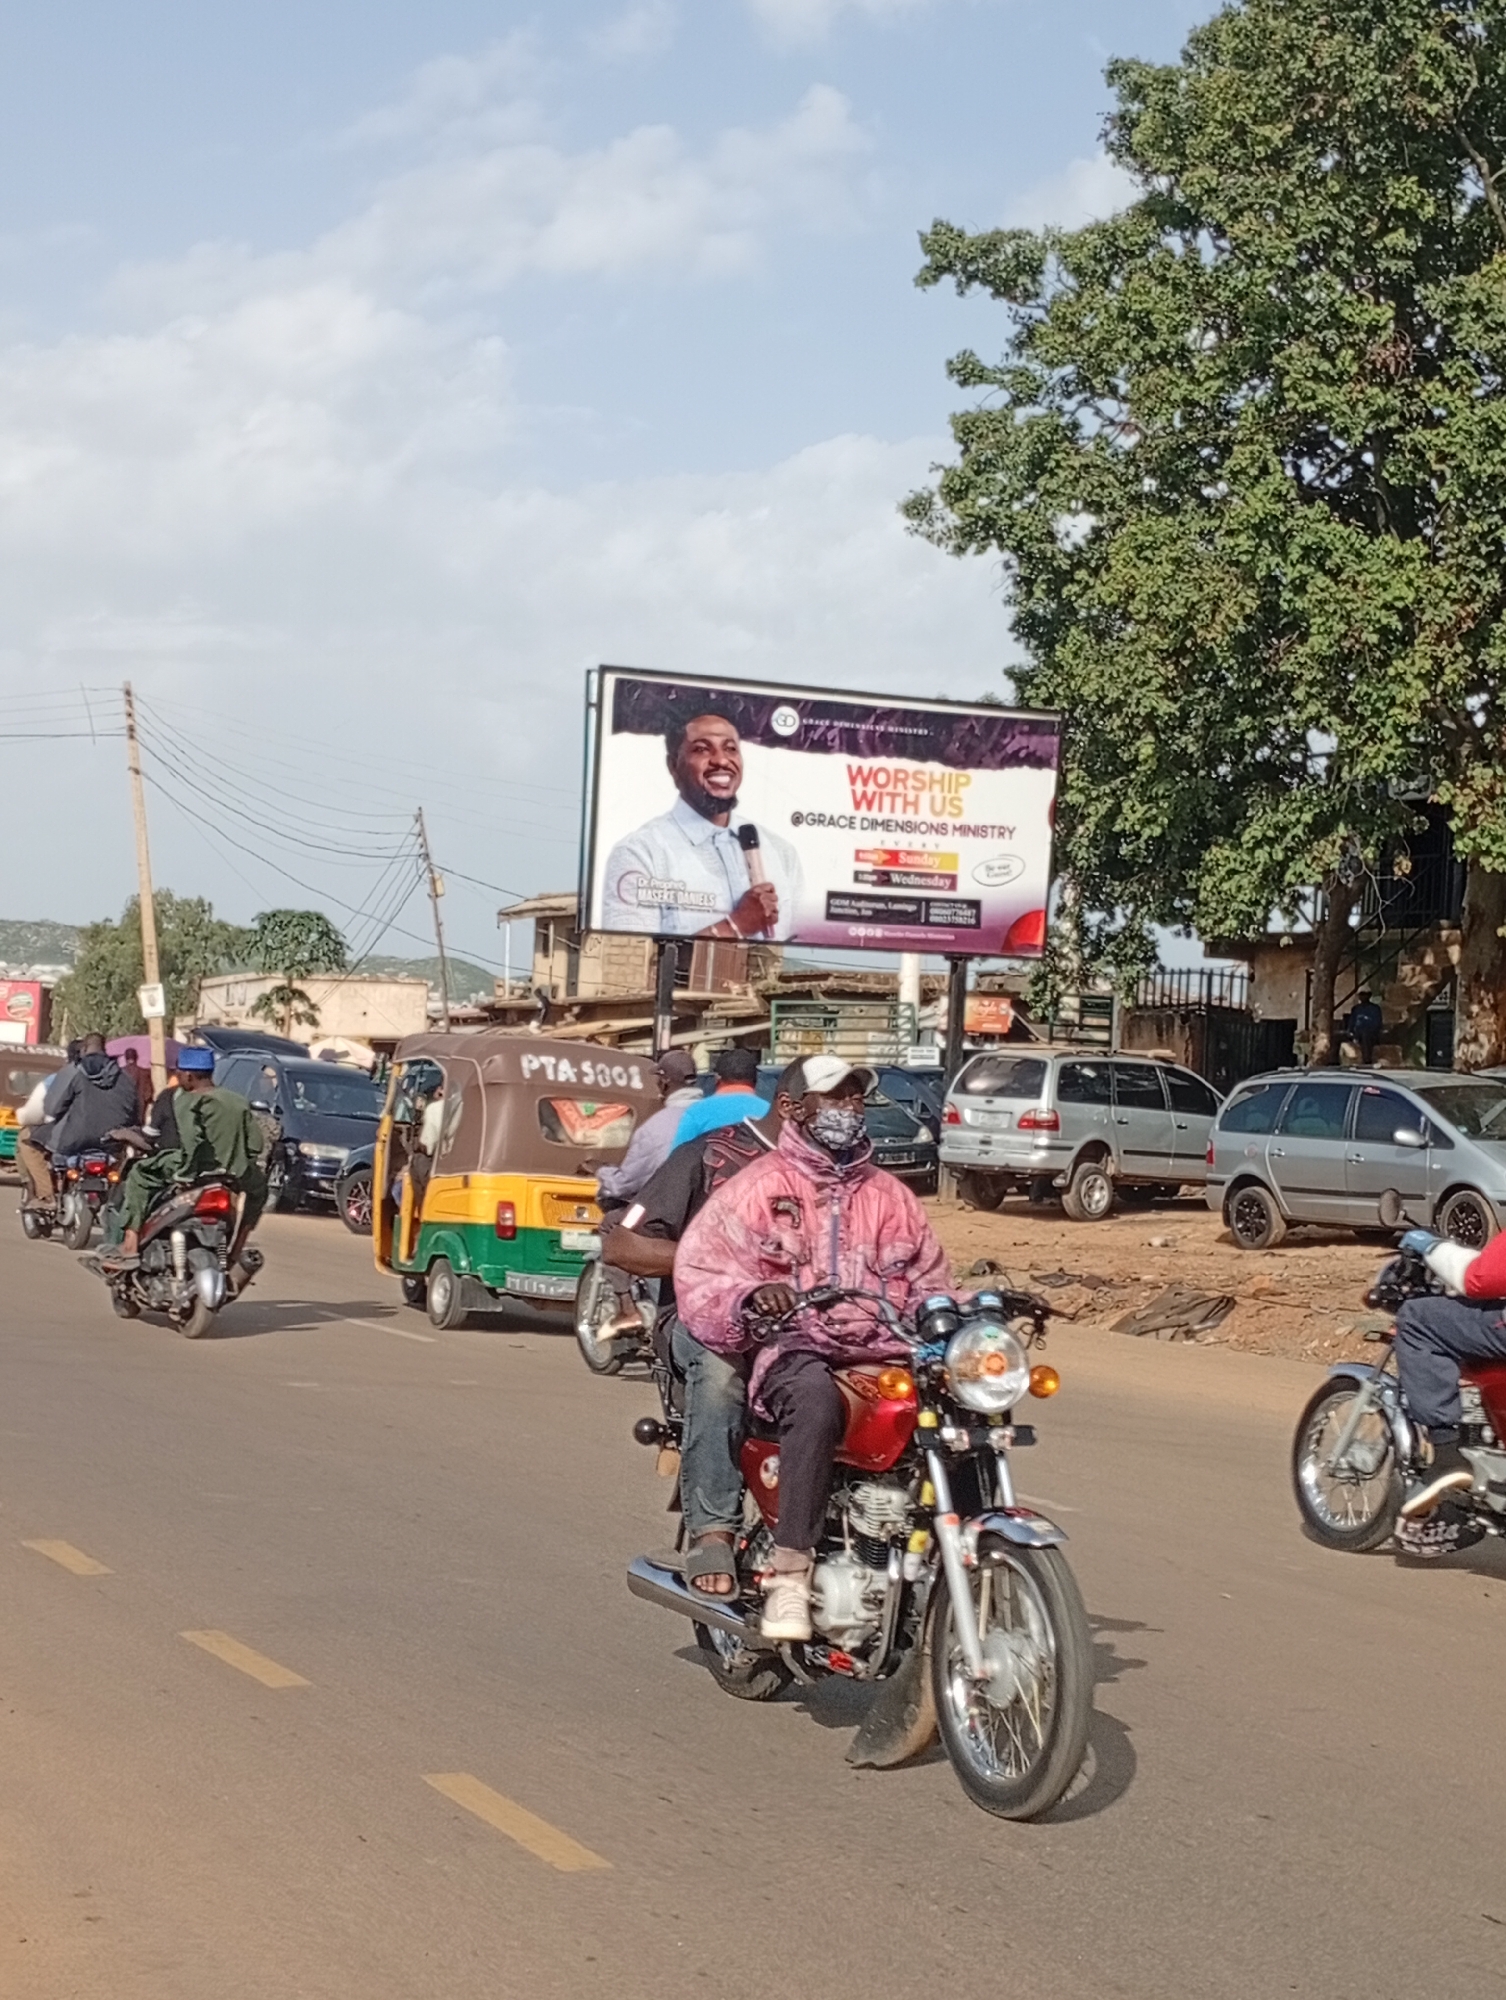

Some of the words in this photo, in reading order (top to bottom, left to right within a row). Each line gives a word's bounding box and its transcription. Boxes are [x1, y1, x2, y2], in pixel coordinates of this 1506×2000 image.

[846, 764, 972, 794] WORSHIP
[850, 789, 920, 815] WITH
[929, 796, 964, 819] US
[790, 811, 857, 830] @GRACE
[860, 817, 949, 836] DIMENSIONS
[951, 824, 1017, 840] MINISTRY
[897, 853, 942, 868] Sunday
[889, 873, 952, 888] Wednesday
[677, 891, 715, 907] DANIELS
